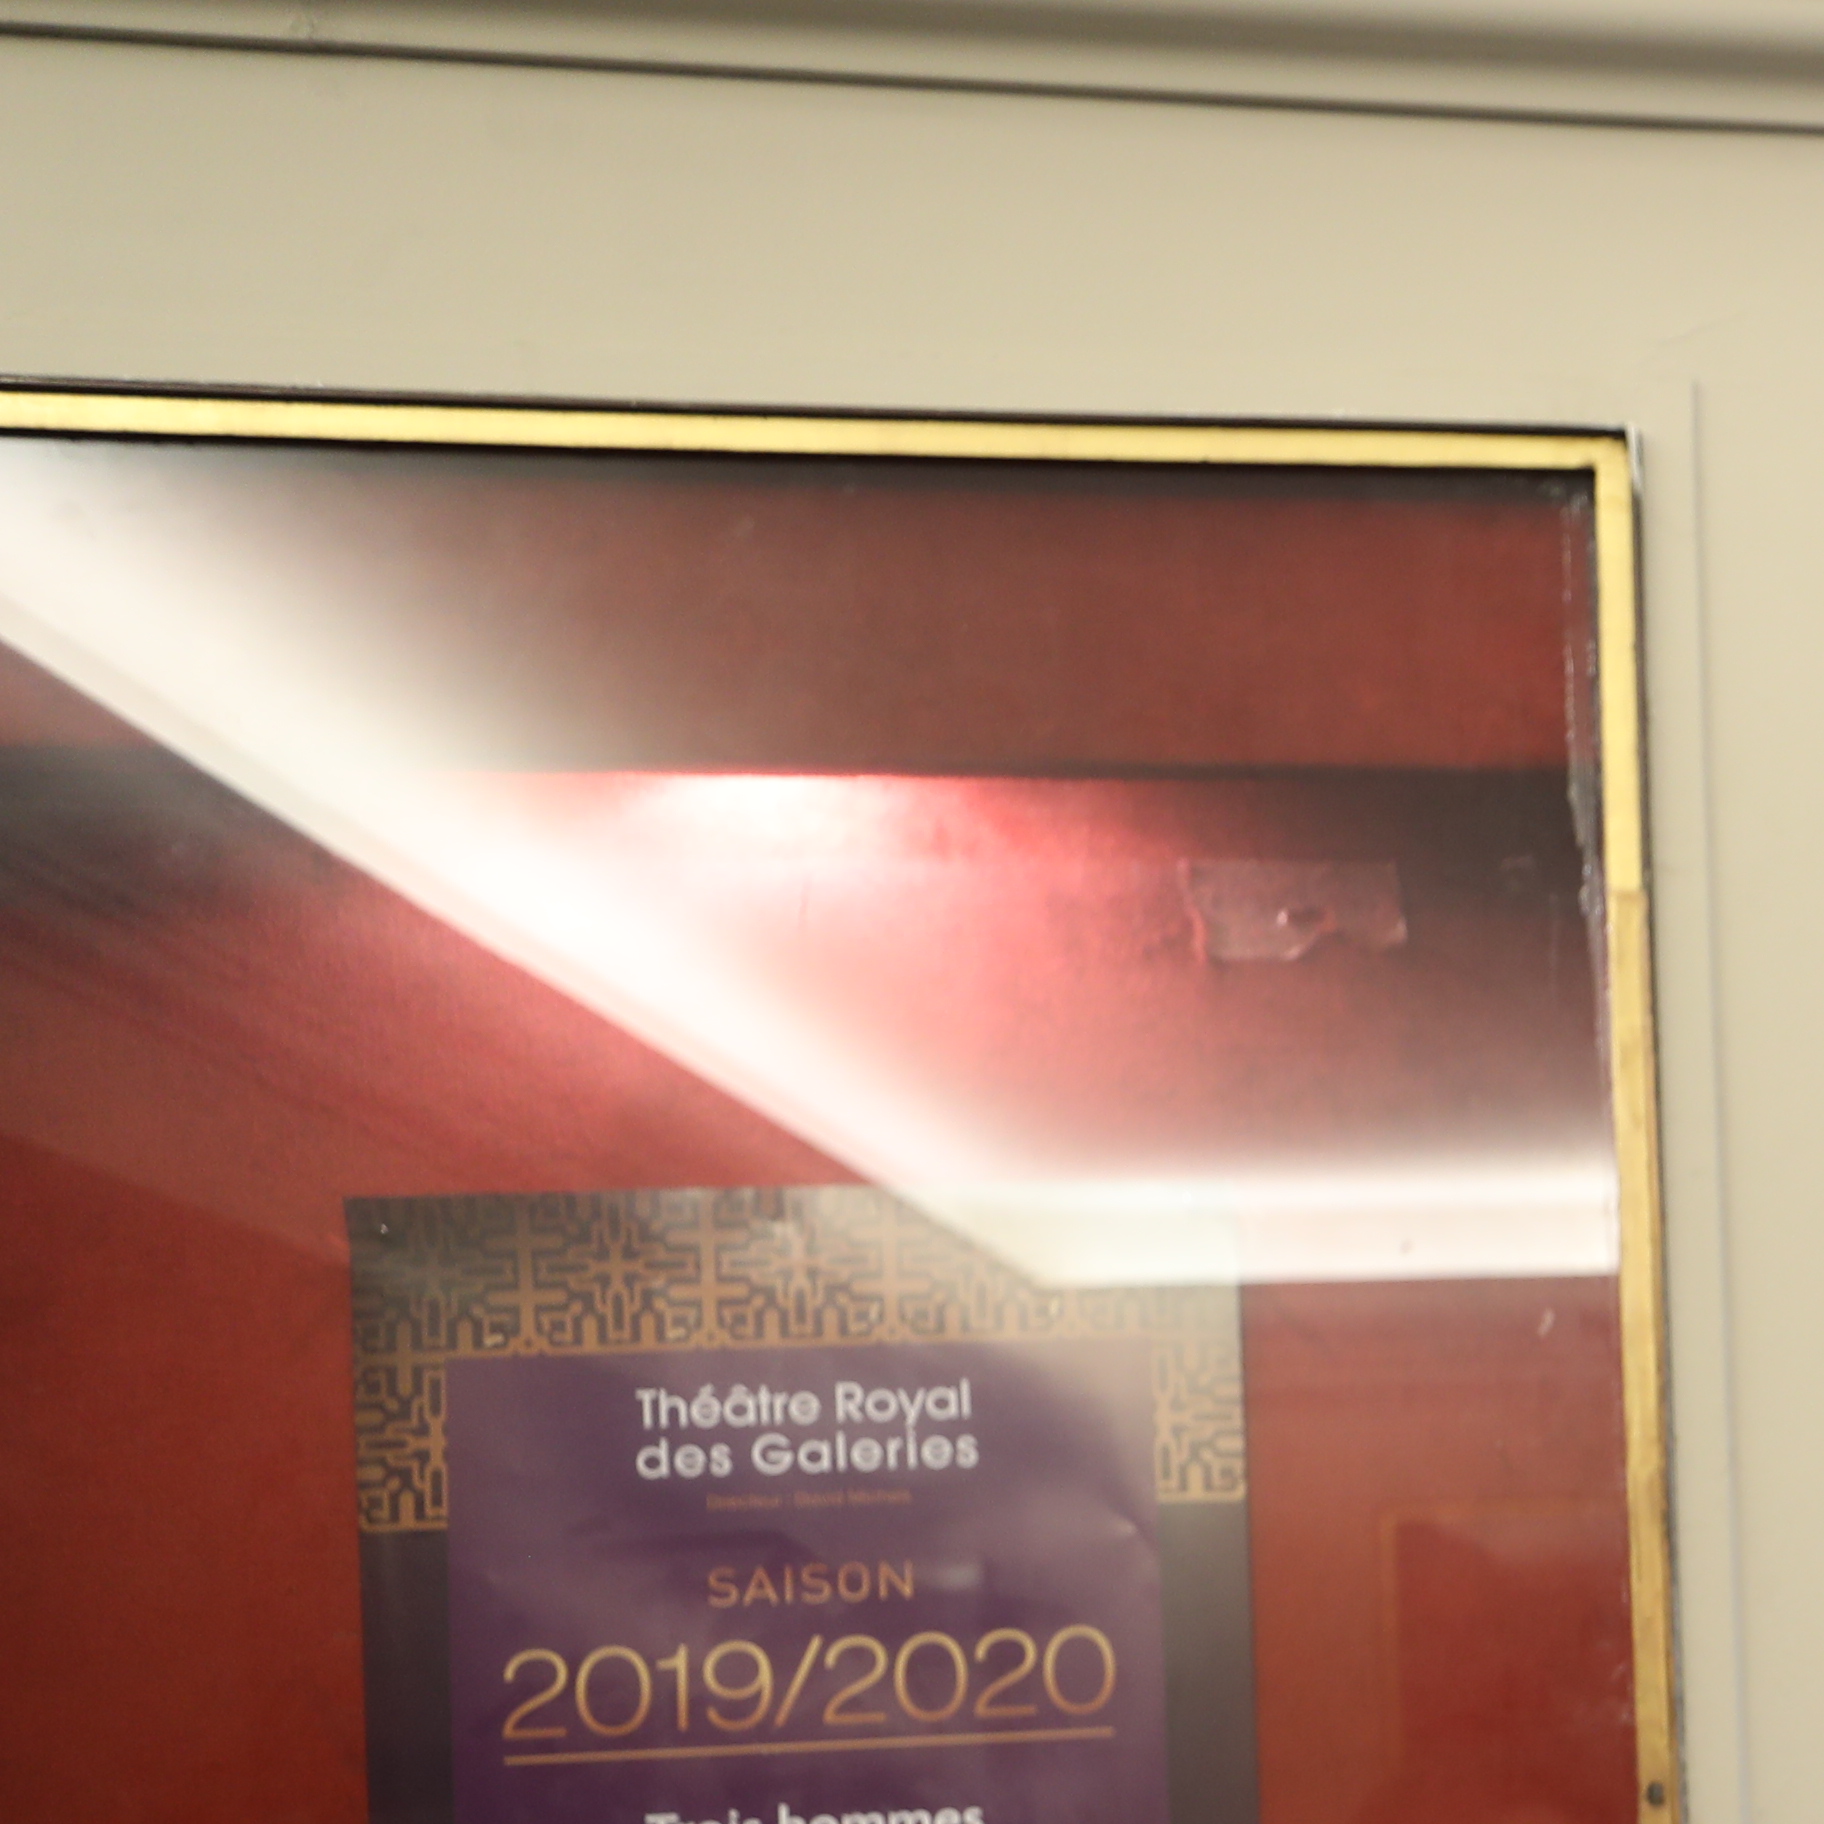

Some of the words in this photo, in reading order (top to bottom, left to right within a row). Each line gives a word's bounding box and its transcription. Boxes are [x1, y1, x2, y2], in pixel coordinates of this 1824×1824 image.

[635, 1381, 822, 1430] Théâtre
[835, 1376, 973, 1431] Royal
[635, 1435, 733, 1480] des
[751, 1427, 980, 1477] Galeries
[707, 1560, 915, 1609] SAISON
[502, 1623, 1118, 1741] 2019/2020
